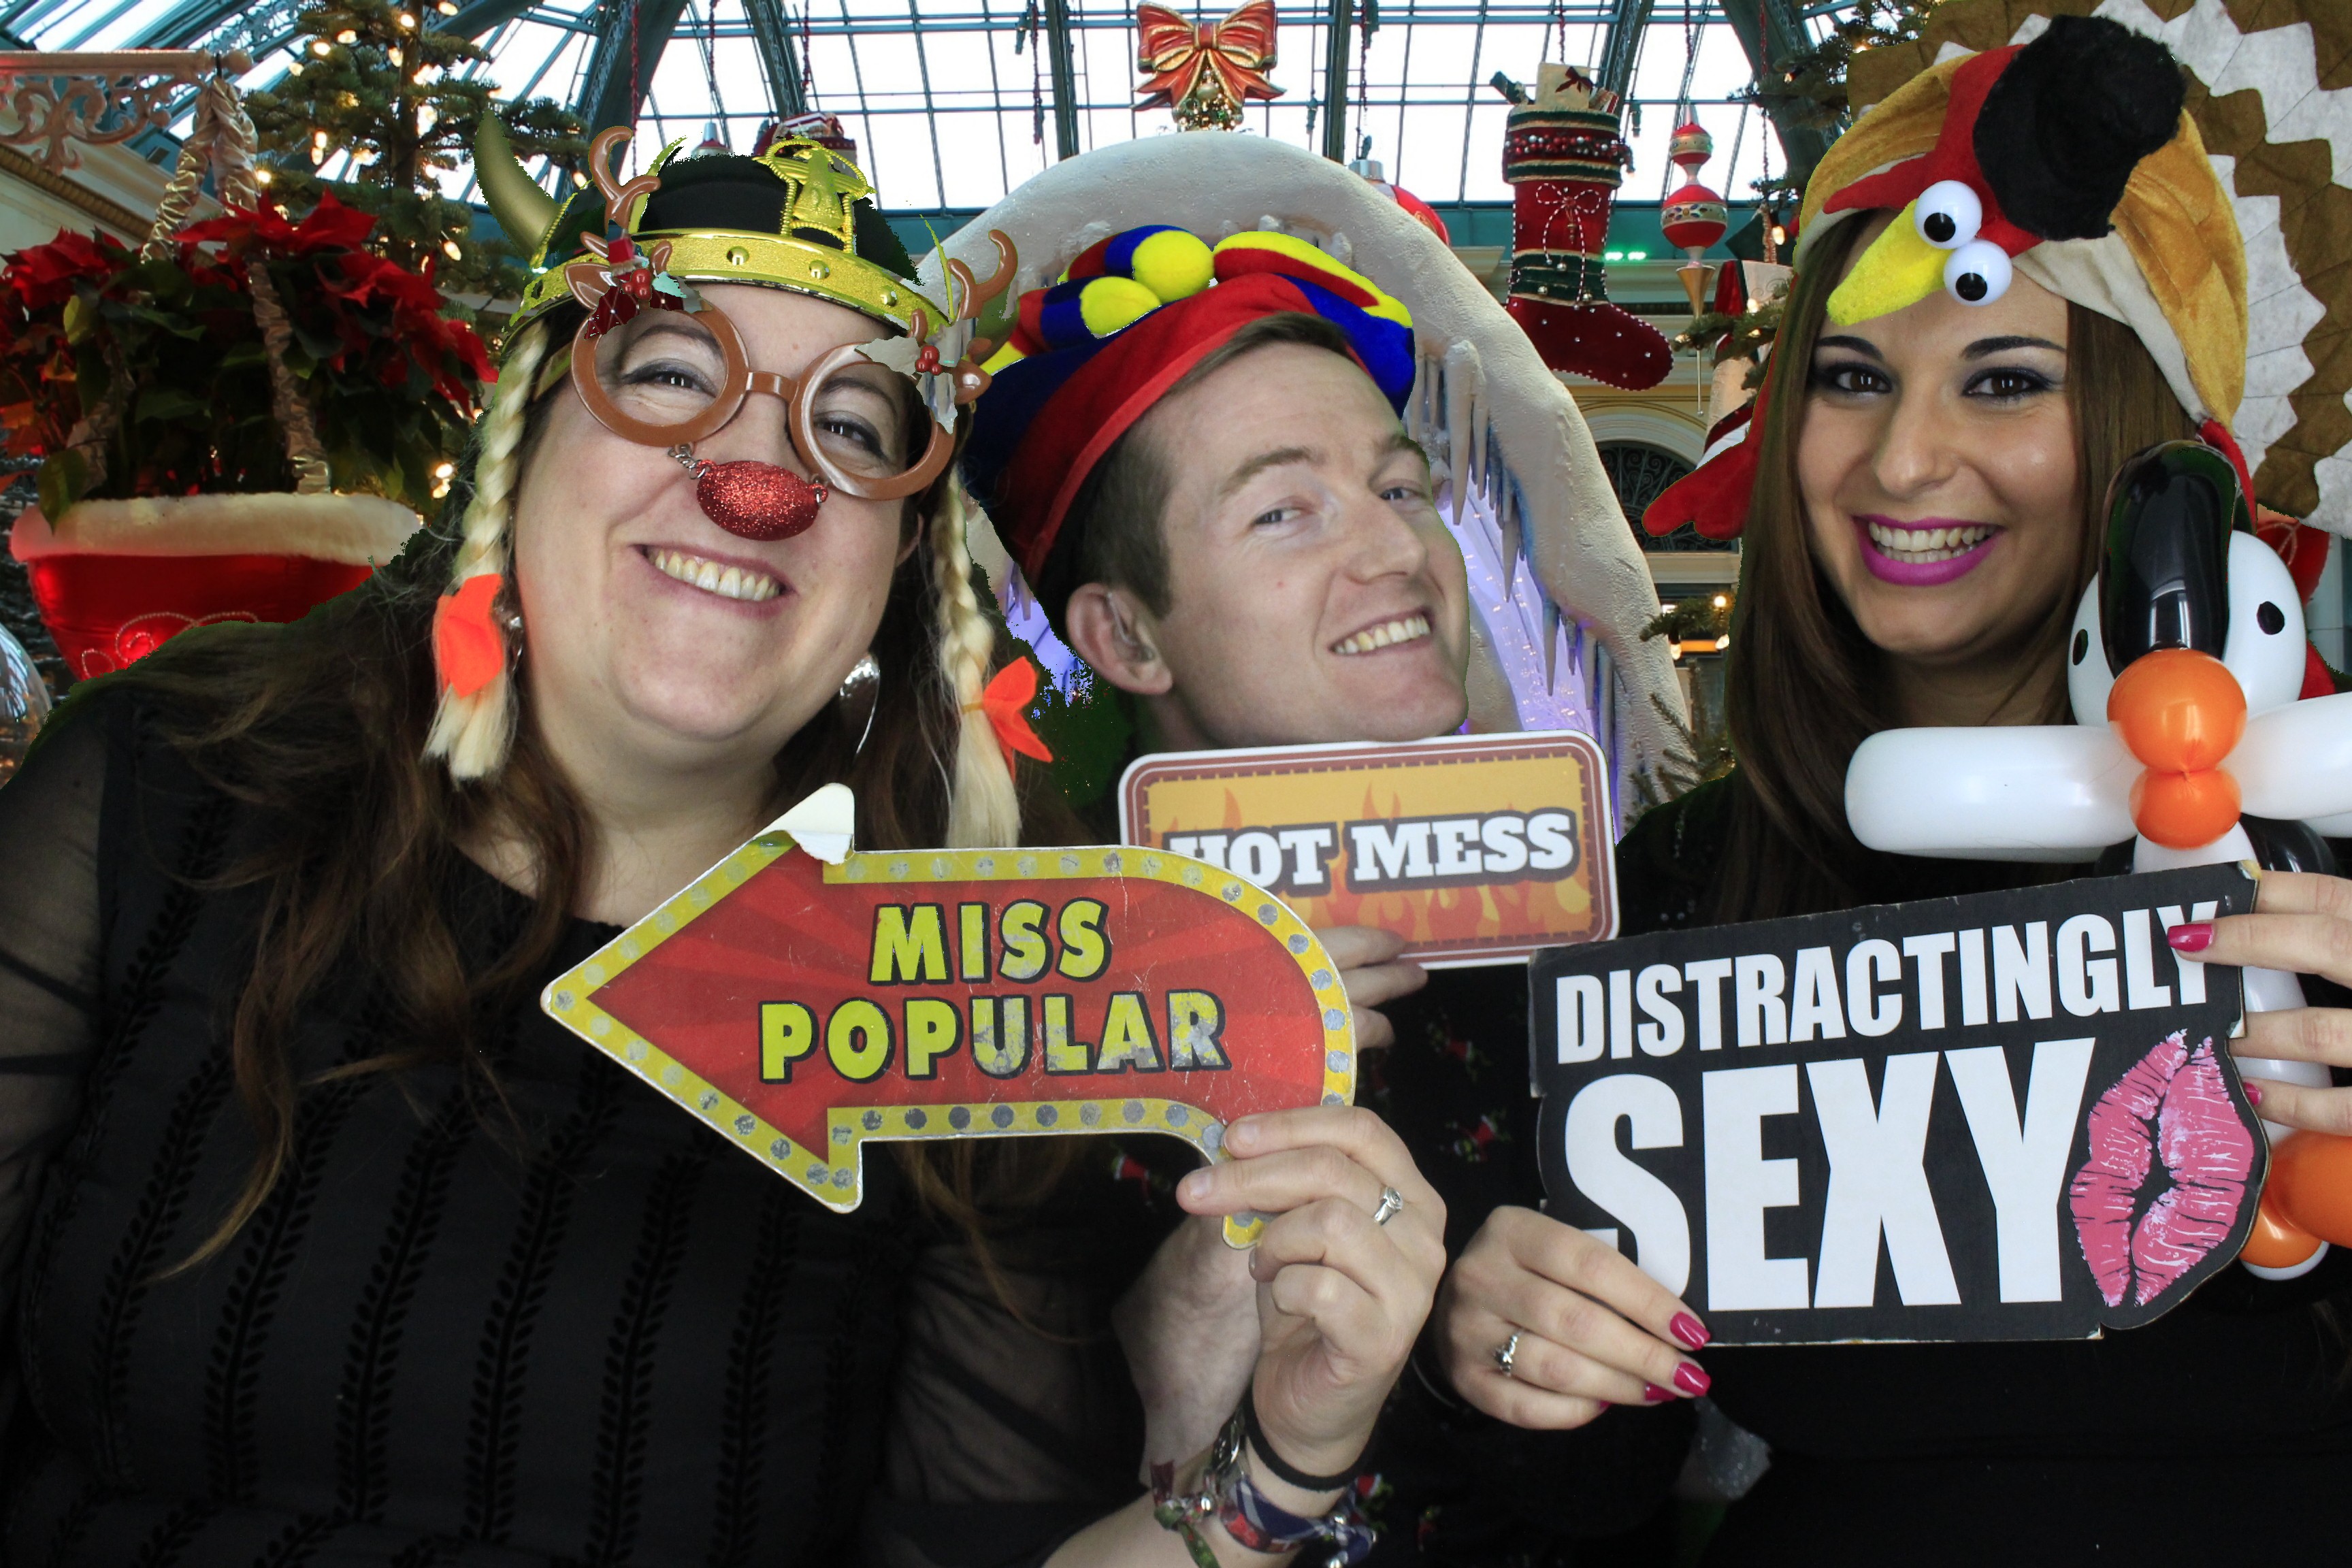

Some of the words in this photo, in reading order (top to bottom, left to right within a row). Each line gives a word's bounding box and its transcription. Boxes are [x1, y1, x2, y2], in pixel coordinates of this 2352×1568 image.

[1350, 813, 1574, 881] MESS
[868, 898, 1112, 985] MISS
[1556, 900, 2219, 1065] DISTRACTINGLY
[759, 989, 1232, 1084] POPULAR
[1565, 1038, 2095, 1312] SEXY
